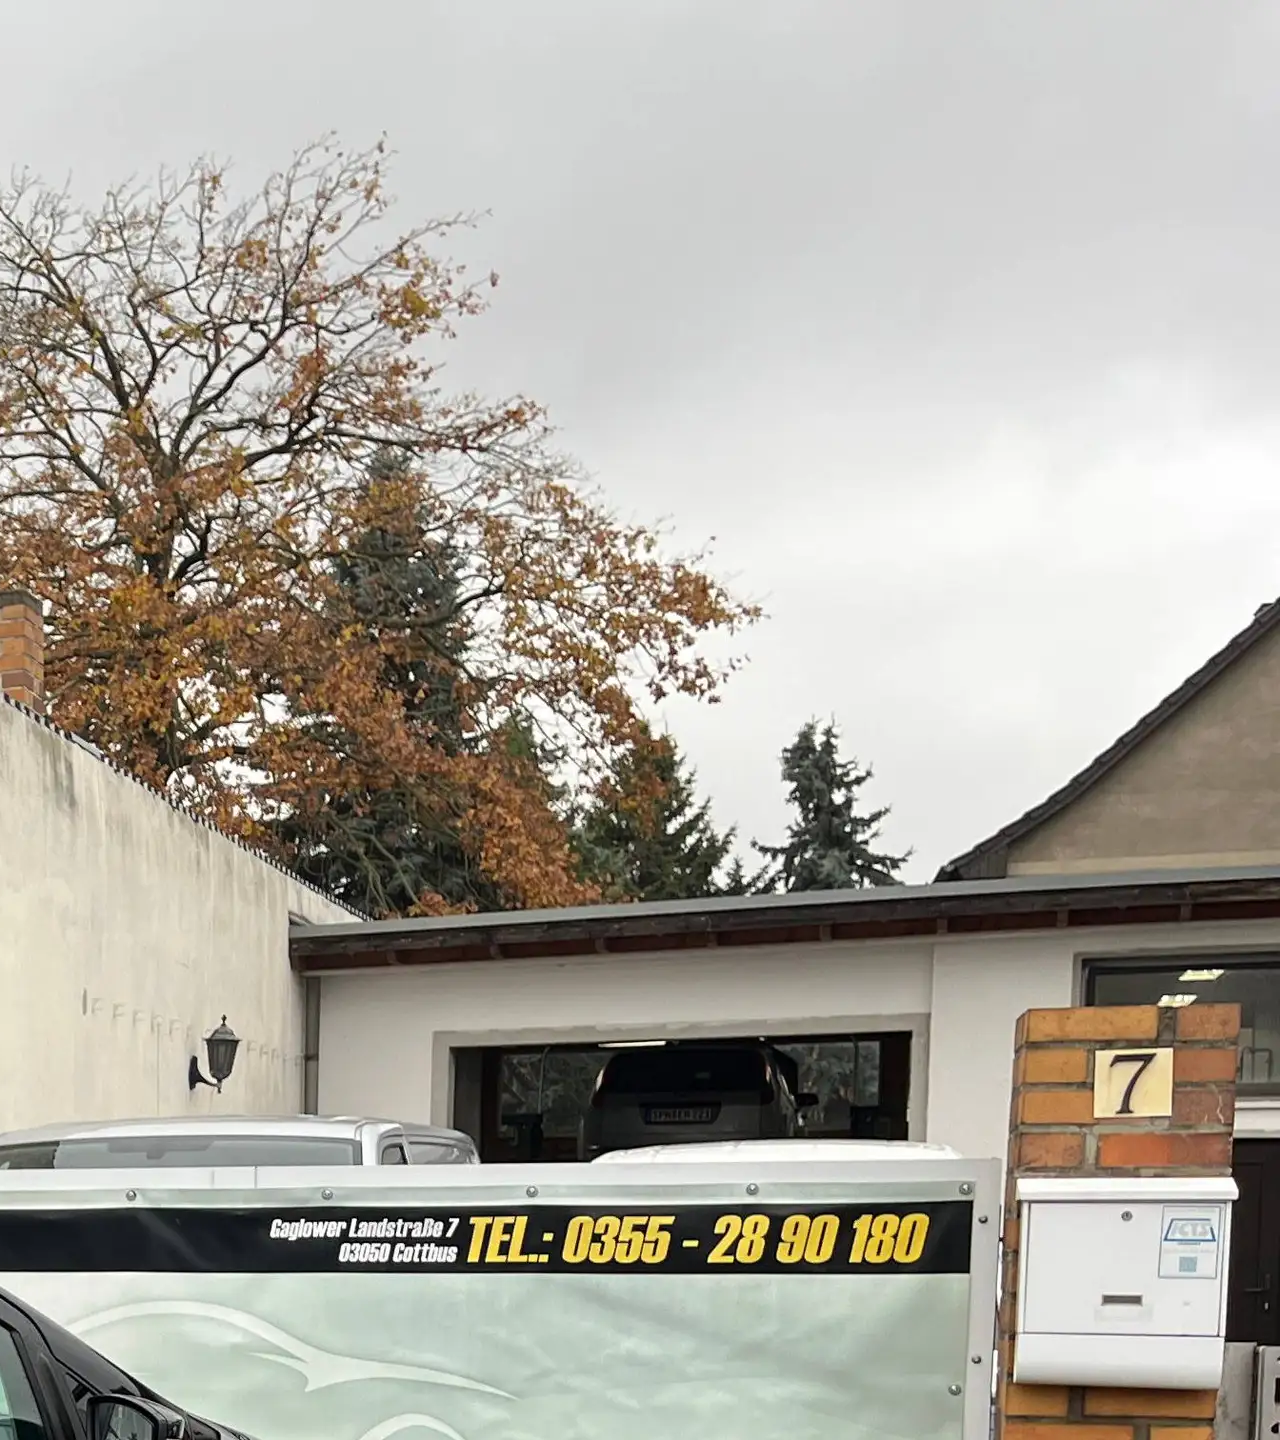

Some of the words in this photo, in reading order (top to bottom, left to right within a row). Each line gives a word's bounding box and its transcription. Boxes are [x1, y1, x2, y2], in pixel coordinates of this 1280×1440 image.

[1109, 1053, 1157, 1115] 7
[270, 1218, 347, 1241] Gaglower
[348, 1217, 444, 1238] Landstraße
[445, 1217, 460, 1238] 7
[466, 1215, 554, 1263] TEL.:
[561, 1215, 676, 1263] 0355
[707, 1214, 770, 1264] 28
[776, 1214, 840, 1264] 90
[848, 1213, 930, 1263] 180
[338, 1242, 391, 1263] 03050
[392, 1242, 458, 1263] Cottbus
